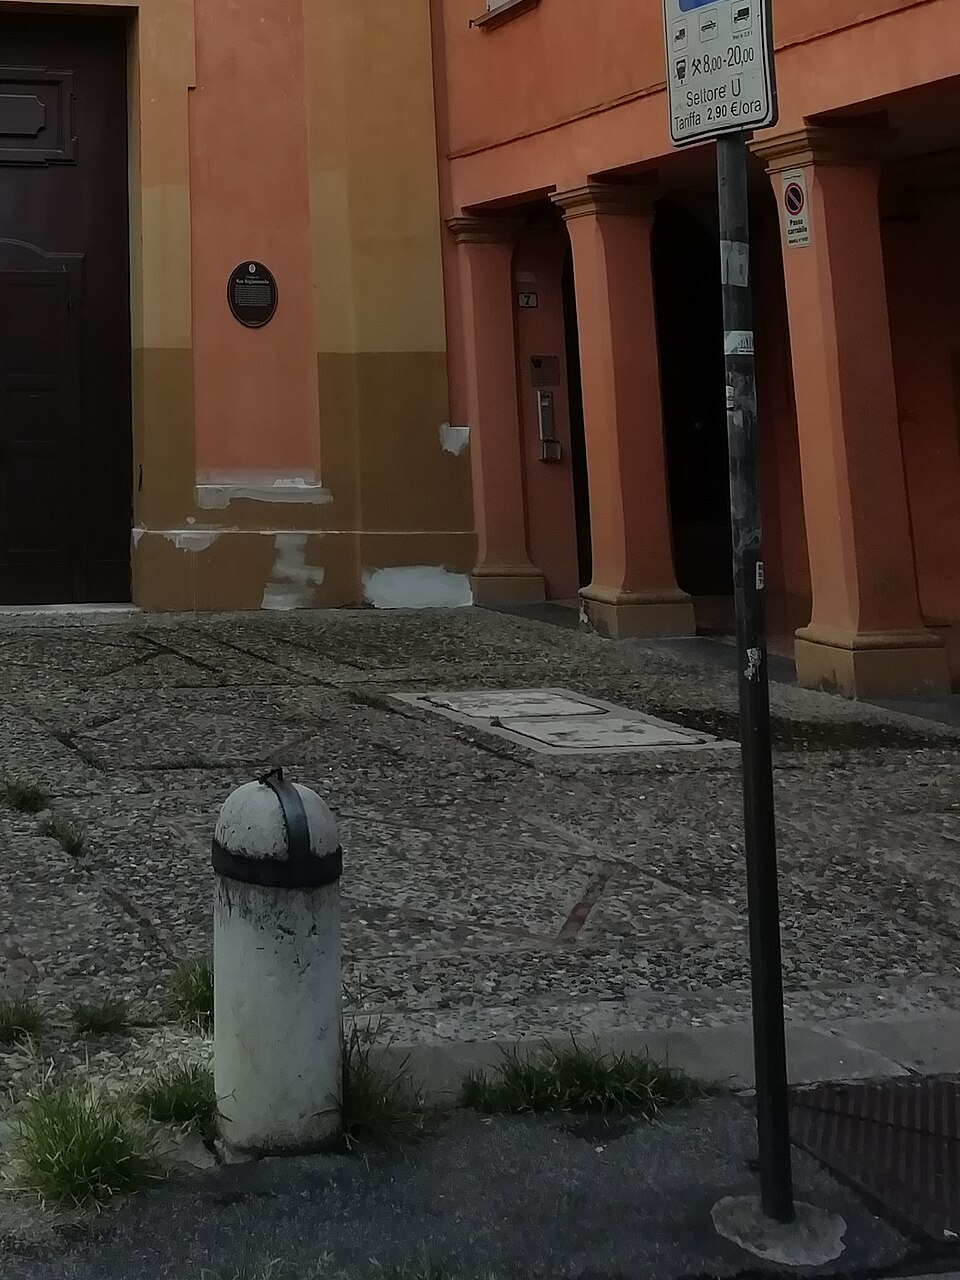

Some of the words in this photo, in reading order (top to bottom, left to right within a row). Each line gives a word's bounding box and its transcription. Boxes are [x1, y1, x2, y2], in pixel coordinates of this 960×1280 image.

[686, 86, 727, 107] Settore
[731, 78, 741, 97] U
[674, 111, 701, 131] Tariffa
[707, 104, 727, 121] 2,90
[730, 99, 762, 117] €/ora
[789, 219, 804, 227] Passo
[787, 226, 808, 235] carrabile
[523, 294, 531, 305] 7
